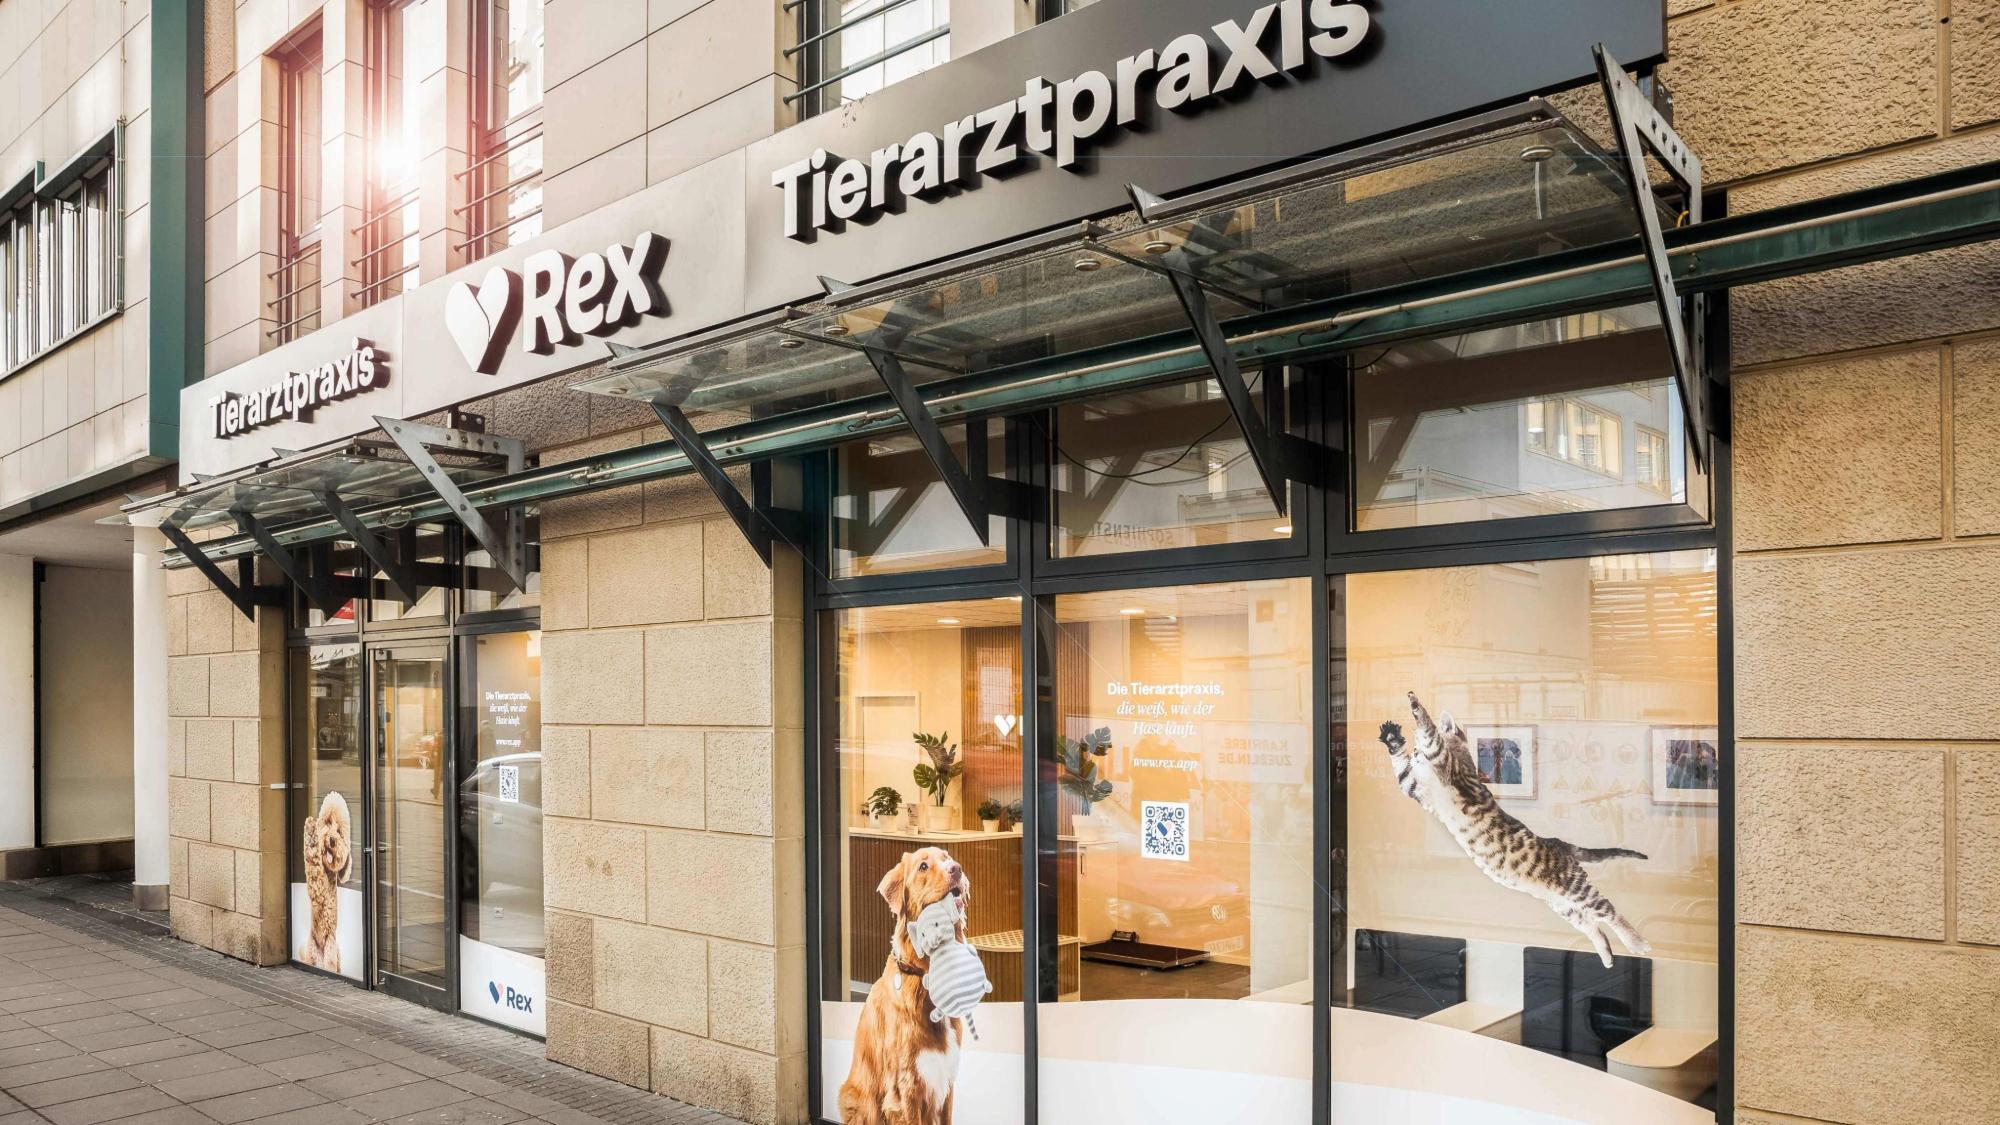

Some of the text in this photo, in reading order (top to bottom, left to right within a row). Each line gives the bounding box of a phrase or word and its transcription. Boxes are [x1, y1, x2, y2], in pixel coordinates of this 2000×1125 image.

[771, 0, 1370, 238] Tierarztpraxis
[522, 230, 652, 353] Rex
[207, 335, 376, 439] Tierarztpraxis
[1107, 680, 1224, 697] Die Tierarztpraxis,
[1116, 701, 1135, 716] die
[1170, 702, 1190, 715] wie
[1192, 700, 1216, 716] der
[1132, 720, 1198, 738] Hase läuft.
[1133, 756, 1198, 772] www.rex.app
[506, 986, 533, 1014] Rex
